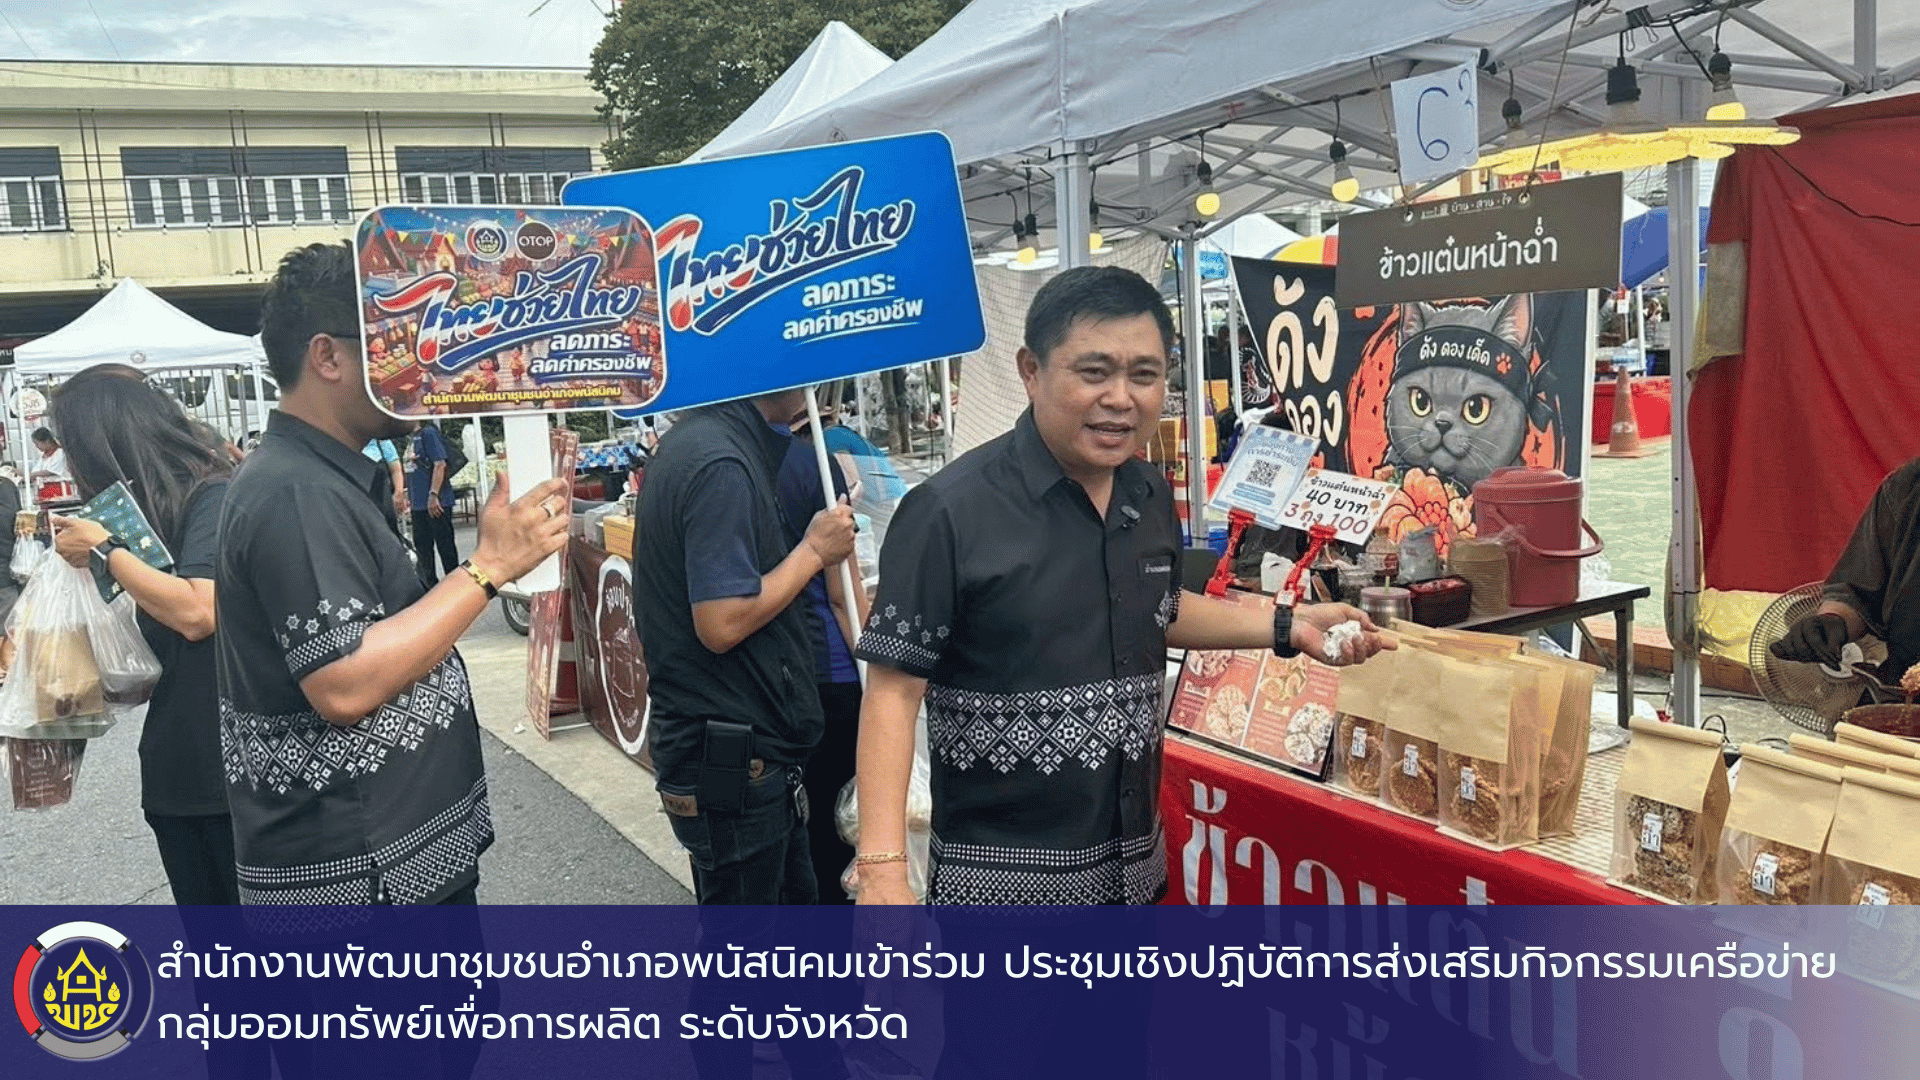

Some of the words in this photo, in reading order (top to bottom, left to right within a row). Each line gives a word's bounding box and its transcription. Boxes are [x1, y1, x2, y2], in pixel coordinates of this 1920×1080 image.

[518, 235, 554, 247] OTOP
[655, 165, 916, 331] ไทยช่วยไทย
[1379, 216, 1558, 280] ข้าวแต๋นหน้าฉ่ำ
[801, 273, 896, 308] ลดภาระ
[372, 252, 642, 365] ไทยช่วยไทย
[782, 297, 924, 340] ลดค่าครองชีพ
[549, 332, 632, 351] ลดภาระ
[1441, 341, 1465, 359] ดอง
[529, 353, 652, 374] ลดค่าครองชีพ
[423, 385, 621, 405] สำนักงานพัฒนาชุมชนอำเภอพนัสนิคม
[1305, 488, 1331, 506] 40
[1333, 496, 1369, 516] บาท
[1310, 475, 1386, 501] ข้าวแต๋นหน้าฉ่ำ
[1284, 502, 1300, 518] 3
[1300, 510, 1324, 528] ถุง
[1331, 512, 1369, 535] 100
